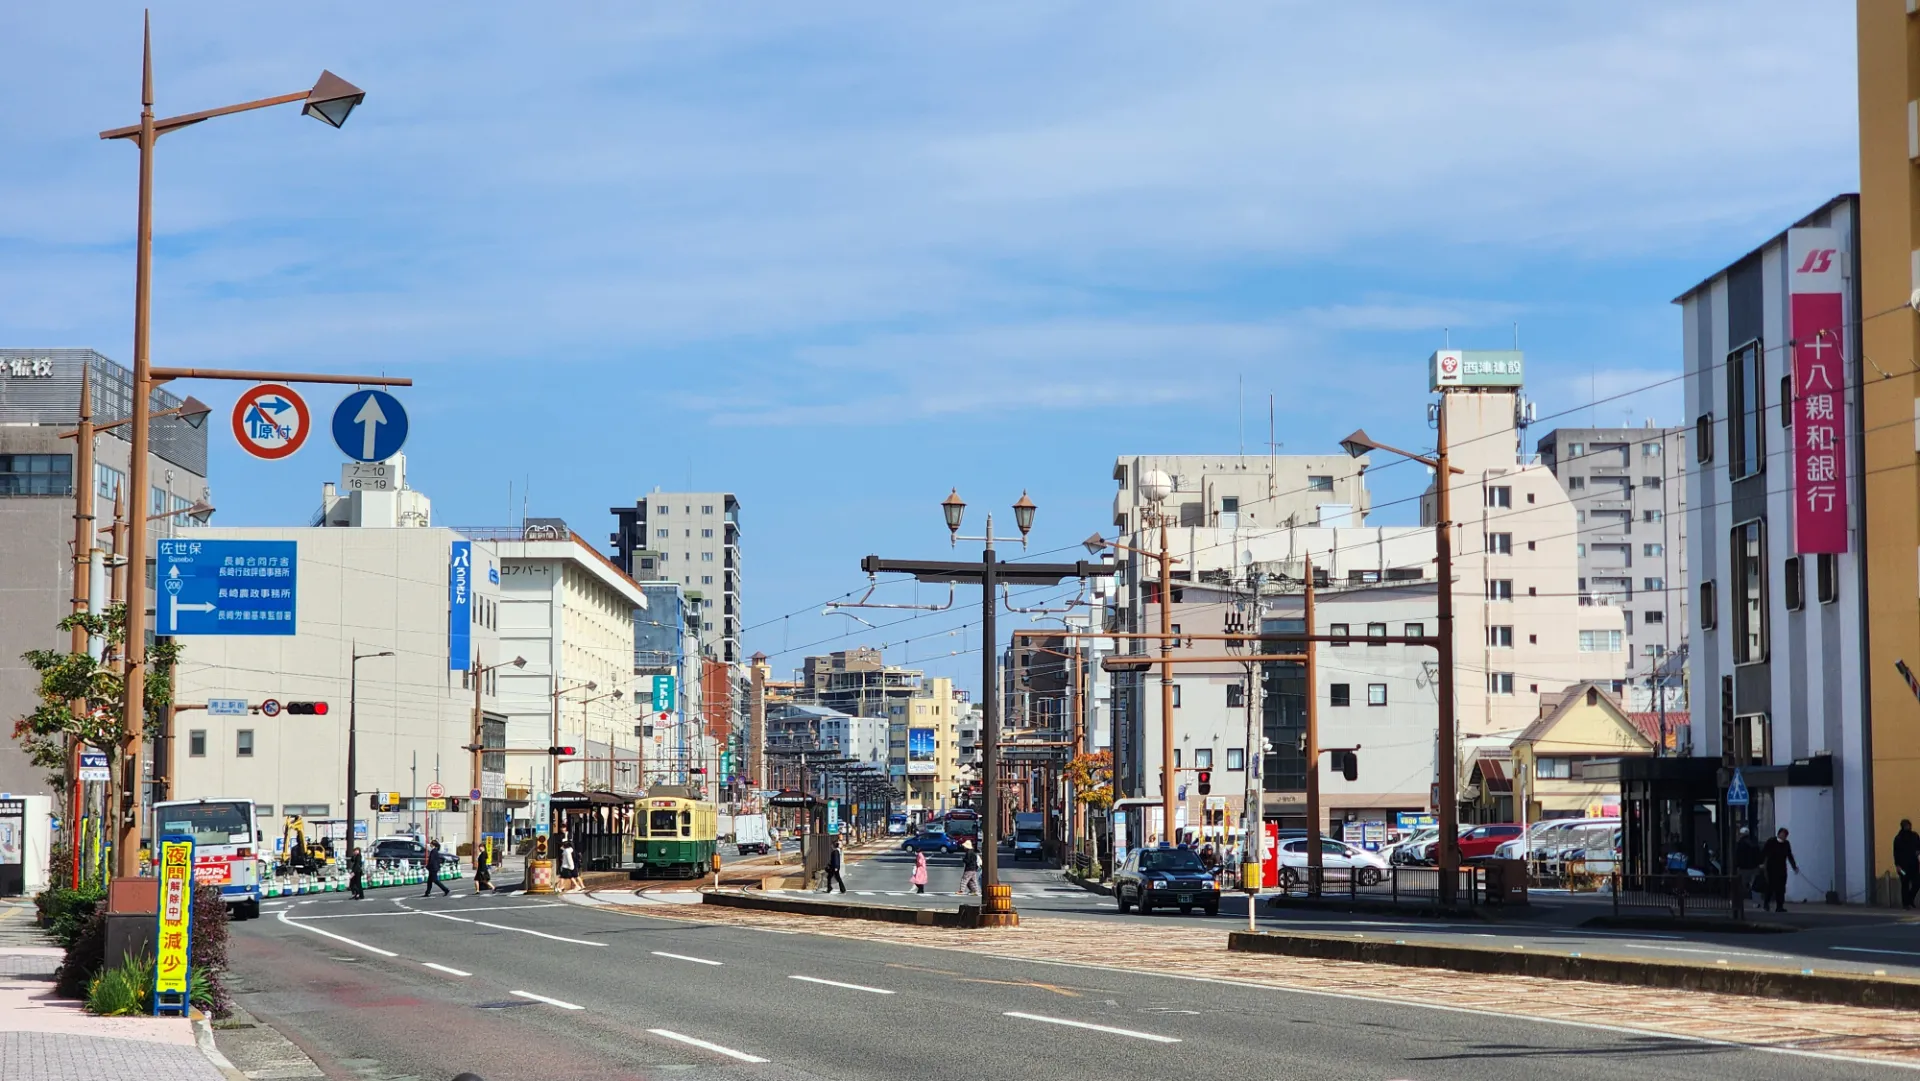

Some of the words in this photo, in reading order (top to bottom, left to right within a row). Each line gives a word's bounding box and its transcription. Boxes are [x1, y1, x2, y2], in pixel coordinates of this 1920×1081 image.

[1797, 249, 1836, 273] JS
[1804, 334, 1837, 513] 十八親和銀行
[258, 424, 292, 440] 原付
[161, 542, 202, 555] 佐世保
[224, 556, 290, 566] 長崎合同庁舎
[219, 567, 290, 577] 長崎行政評価事務所
[168, 581, 180, 590] 206
[218, 588, 291, 598] 長崎農政事務所
[456, 567, 466, 604] ろうきん
[659, 677, 669, 710] ニトリ
[169, 882, 180, 916] 解除中
